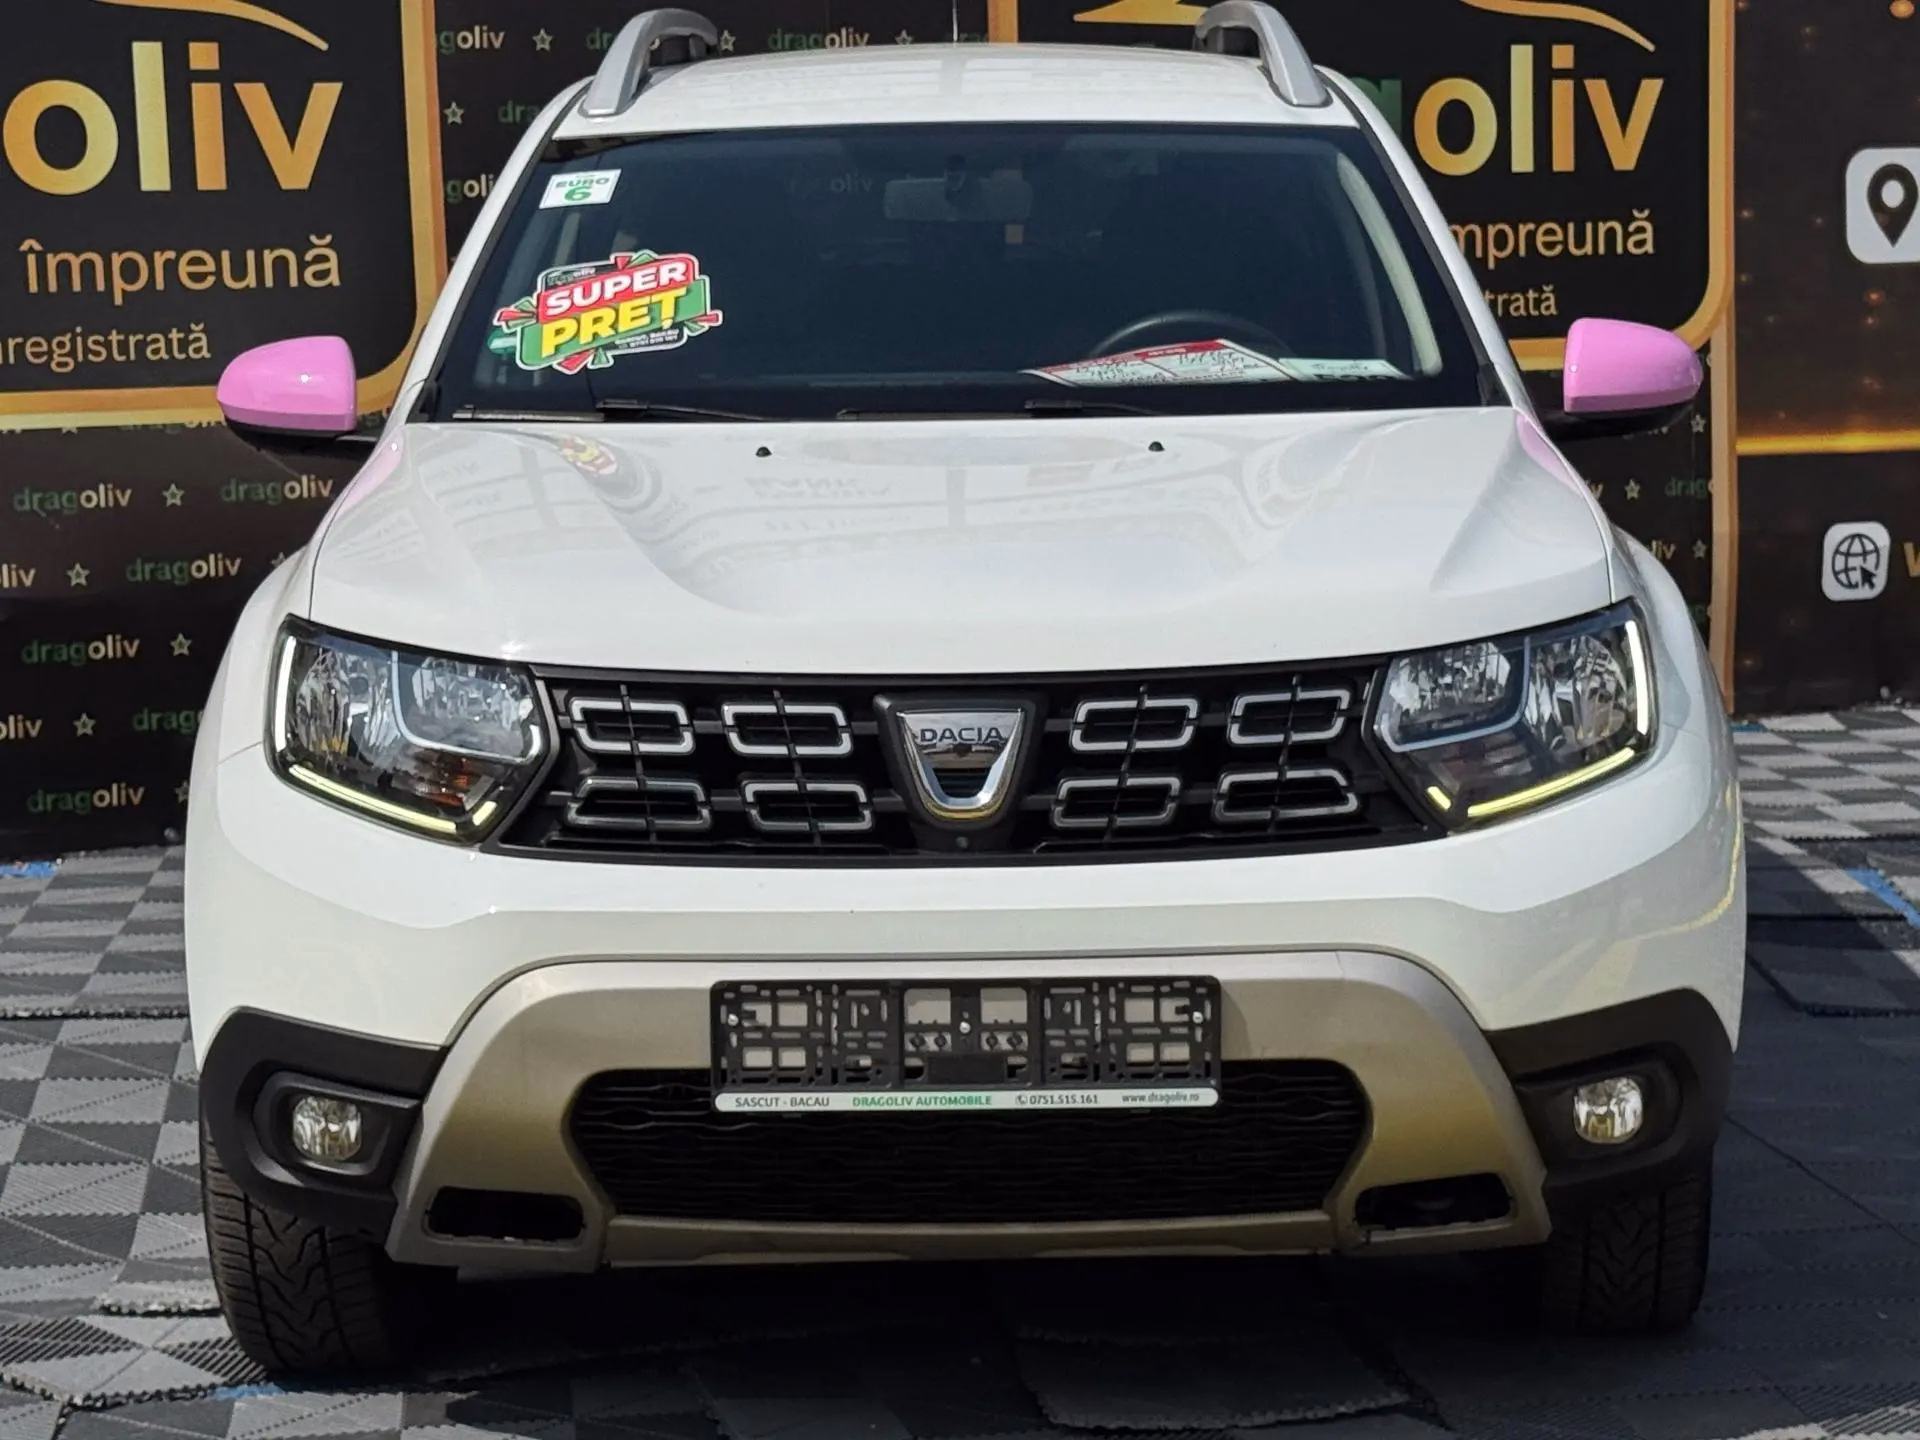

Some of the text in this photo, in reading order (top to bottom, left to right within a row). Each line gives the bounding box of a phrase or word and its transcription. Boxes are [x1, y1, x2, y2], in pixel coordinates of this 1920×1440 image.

[3, 41, 343, 196] oliv
[555, 177, 610, 188] EURO
[564, 186, 593, 201] 6
[19, 234, 341, 306] împreună
[546, 261, 687, 316] SUPER
[0, 322, 211, 373] registrată
[13, 482, 132, 515] dragoliv
[221, 474, 333, 505] dragoliv
[0, 563, 36, 589] liv
[126, 553, 242, 586] dragoliv
[21, 634, 141, 667] dragoliv
[132, 707, 204, 735] drag
[919, 727, 1003, 743] DACIA
[27, 781, 146, 815] dragoliv
[735, 1096, 781, 1108] SASCUT
[852, 1096, 913, 1107] DRAGOLIV
[916, 1095, 992, 1107] AUTOMOBILE
